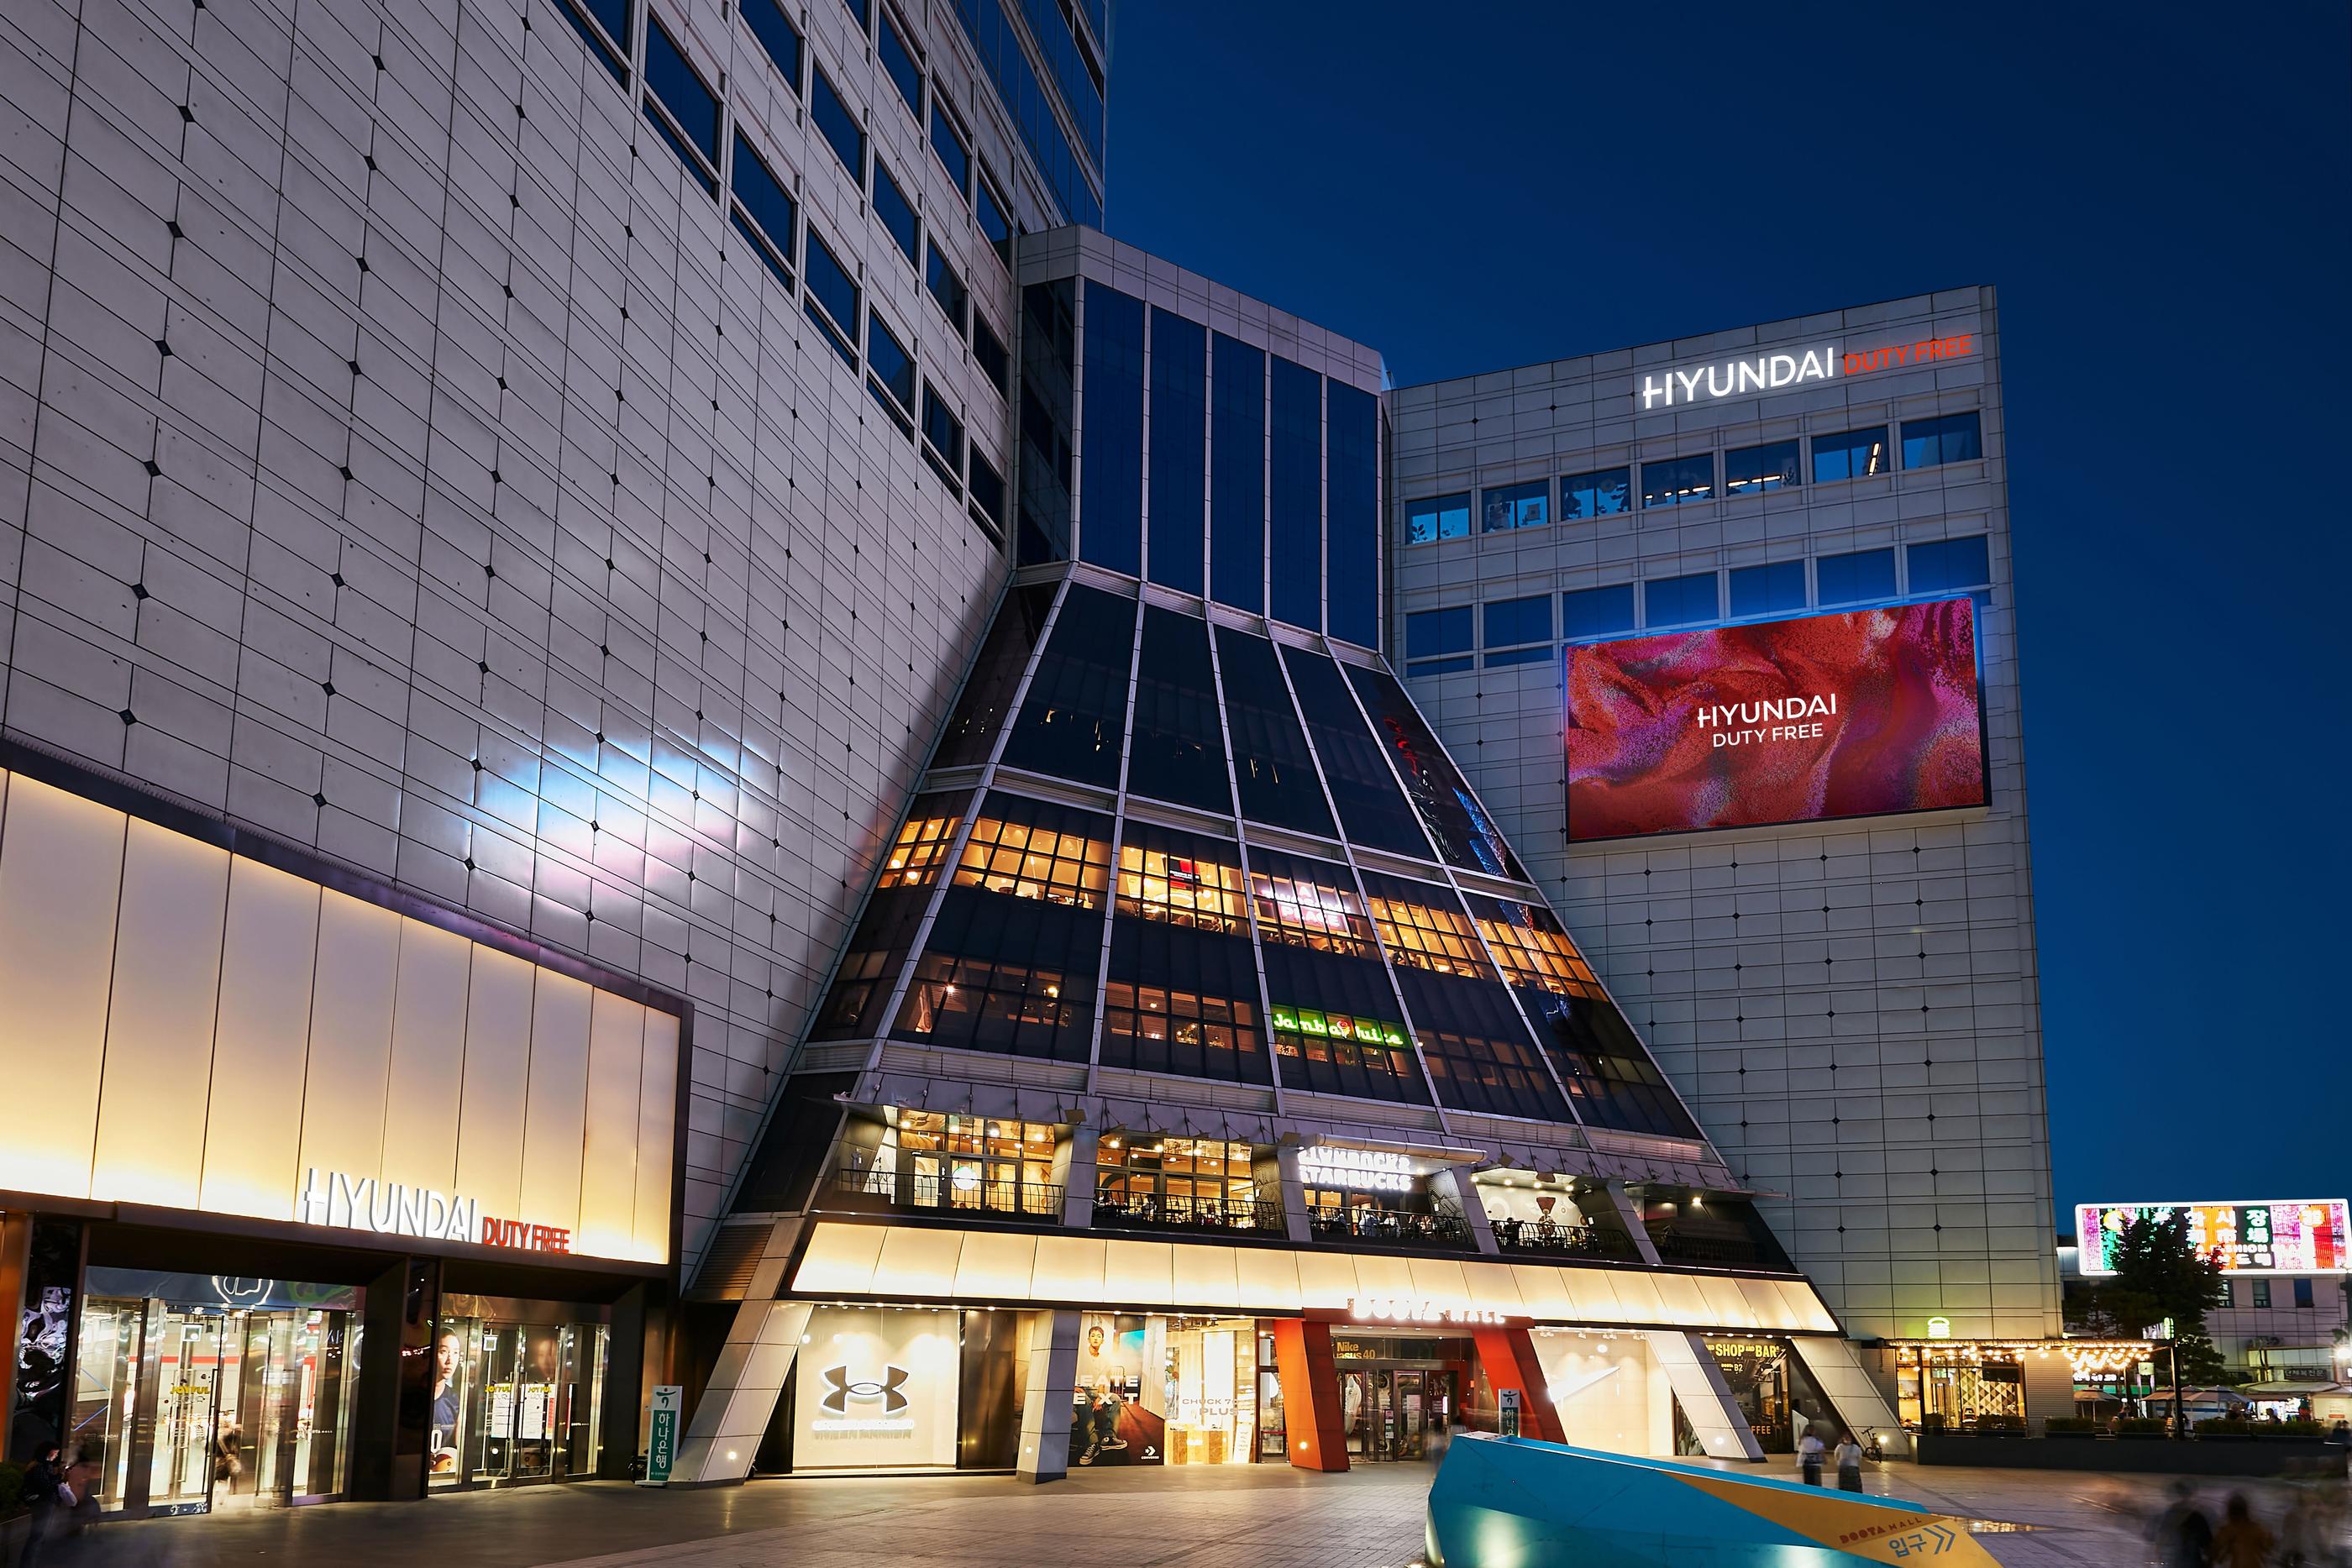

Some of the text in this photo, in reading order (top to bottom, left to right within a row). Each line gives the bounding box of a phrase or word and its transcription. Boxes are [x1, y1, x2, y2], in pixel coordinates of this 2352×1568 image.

[1642, 334, 1973, 409] HYUNDAI DUTY FREE
[1698, 694, 1836, 728] HYUNDAI
[1713, 723, 1824, 747] DUTY FREE
[1281, 907, 1341, 927] PLACE
[1299, 1165, 1412, 1191] STARBUCKS
[304, 1167, 570, 1254] HYUNDAI DUTY FREE
[1336, 1341, 1359, 1352] Nike
[1362, 1350, 1376, 1360] 40
[1715, 1344, 1745, 1357] SHOP
[1734, 1363, 1743, 1371] B2
[170, 1386, 210, 1395] JOYFUL
[1080, 1375, 1138, 1387] EATE
[1200, 1408, 1239, 1416] PLUS
[655, 1413, 671, 1469] 하나은행
[1840, 1517, 1922, 1544] DOOTA MALL
[1888, 1534, 1927, 1558] 입구
